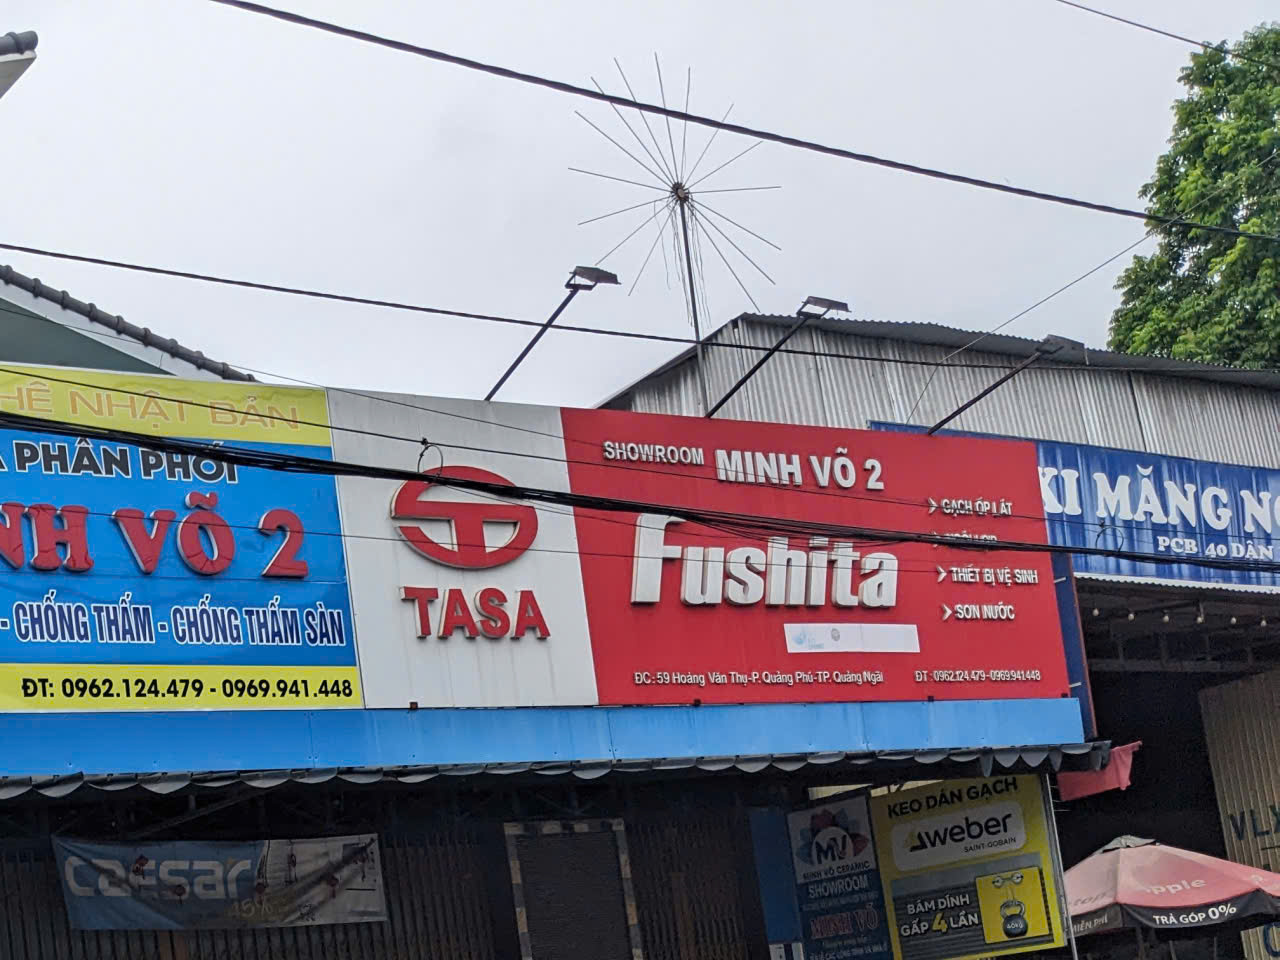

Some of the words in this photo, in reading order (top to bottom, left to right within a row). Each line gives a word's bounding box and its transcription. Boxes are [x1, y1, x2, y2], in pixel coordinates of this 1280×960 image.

[69, 390, 195, 429] NHẬT
[208, 395, 301, 431] BẢN
[14, 437, 131, 479] PHÂN
[602, 440, 705, 466] SHOWROOM
[715, 449, 803, 486] MINH
[809, 446, 858, 490] VÕ
[863, 458, 885, 491] 2
[1093, 463, 1232, 531] MĂNG
[1240, 489, 1280, 534] N
[111, 491, 235, 577] VÕ
[257, 509, 310, 579] 2
[1156, 535, 1198, 554] PCB
[1205, 542, 1228, 558] 40
[1231, 540, 1274, 561] DÂN
[630, 512, 899, 609] Fushita
[950, 563, 981, 583] THIẾT
[983, 567, 996, 587] BỊ
[997, 566, 1013, 587] VỆ
[1014, 569, 1039, 584] SINH
[13, 588, 89, 644] CHỐNG
[91, 591, 156, 645] THẤM
[170, 592, 242, 646] CHỐNG
[247, 594, 303, 646] THẤM
[304, 601, 347, 648] SÀN
[398, 585, 551, 641] TASA
[955, 603, 980, 620] SƠN
[982, 601, 1016, 621] NƯỚC
[22, 678, 55, 698] ĐT:
[61, 678, 204, 699] 0962.124.479
[222, 679, 353, 700] 0969.941.448
[657, 672, 670, 684] 59
[672, 671, 705, 687] Hoàng
[708, 671, 727, 684] Văn
[762, 670, 793, 686] Quảng
[833, 670, 862, 685] Quảng
[863, 670, 884, 686] Ngãi
[887, 798, 922, 820] KEO
[926, 788, 963, 811] DÁN
[966, 776, 1018, 802] GẠCH
[926, 812, 1013, 850] weber
[808, 874, 869, 899] SHOWROOM
[907, 898, 935, 915] BÁM
[938, 893, 970, 910] DÍNH
[900, 918, 929, 936] GẤP
[931, 912, 948, 933] 4
[950, 910, 980, 930] LẦN
[1153, 912, 1178, 926] TRẢ
[1179, 910, 1206, 924] GÓP
[1208, 903, 1237, 921] 0%
